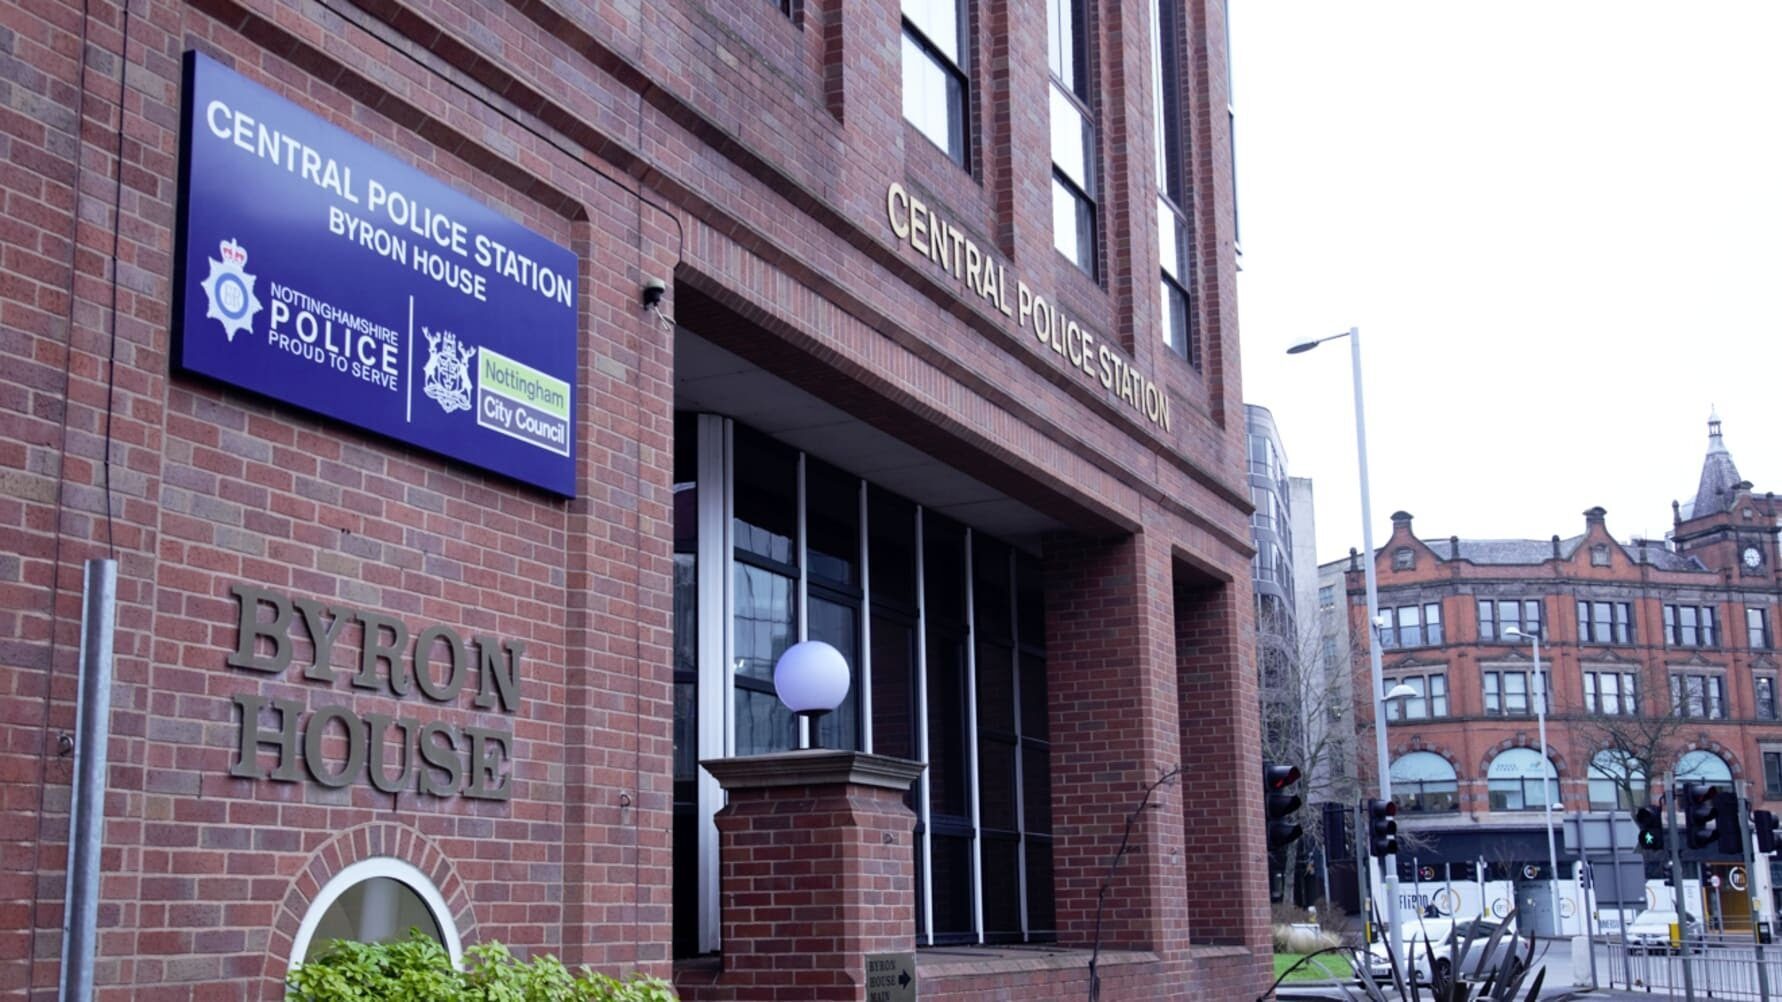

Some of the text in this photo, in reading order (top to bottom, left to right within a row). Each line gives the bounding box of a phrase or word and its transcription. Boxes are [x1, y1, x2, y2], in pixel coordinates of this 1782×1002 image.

[206, 100, 572, 307] CENTRAL POLICE STATION
[329, 206, 487, 302] BYRON HOUSE
[270, 281, 399, 346] NOTTINGHAMSHIRE
[270, 298, 399, 376] POLICE
[887, 182, 1171, 433] CENTRAL POLICE STATION
[268, 330, 398, 392] PROUD TO SERVE
[485, 359, 564, 409] Nottingham
[484, 395, 565, 445] City Council
[227, 584, 526, 714] BYRON
[229, 693, 513, 801] HOUSE
[869, 960, 896, 972] BYRON
